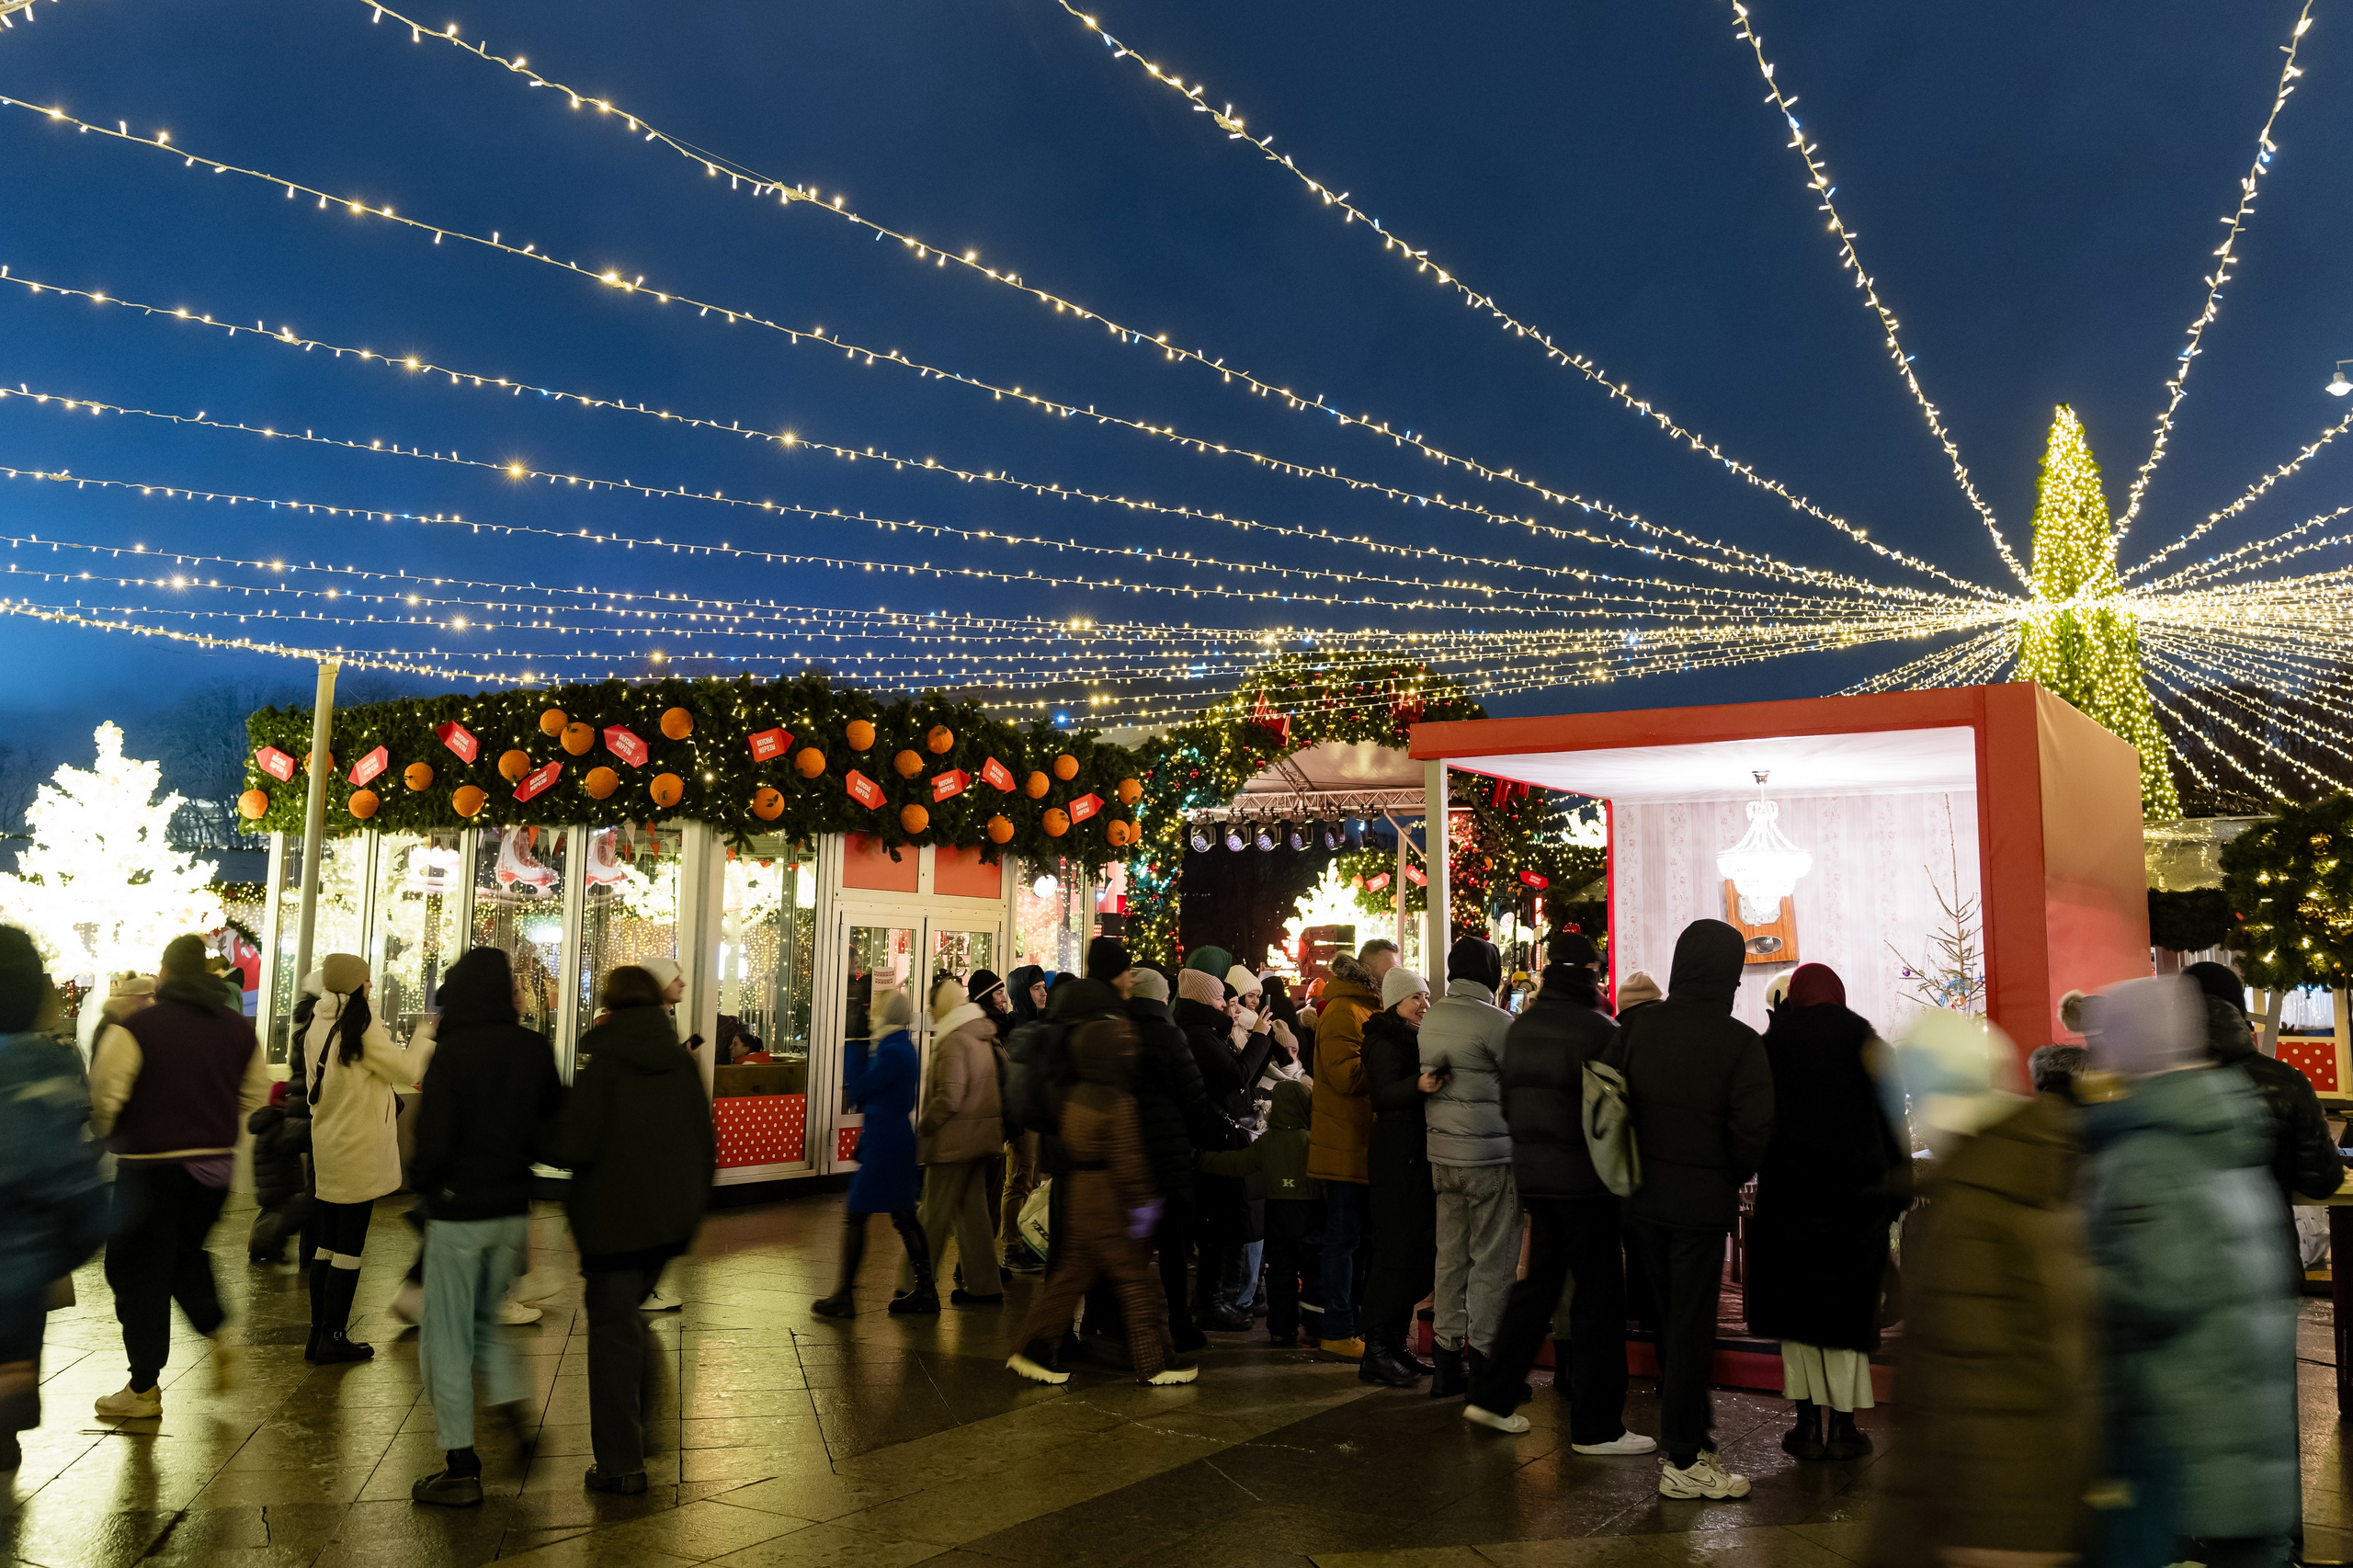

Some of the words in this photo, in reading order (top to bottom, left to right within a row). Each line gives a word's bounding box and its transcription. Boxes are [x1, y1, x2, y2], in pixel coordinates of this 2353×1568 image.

[618, 733, 636, 749] ВКУСНЫЕ
[756, 735, 774, 746] ВКУСНЫЕ
[616, 740, 633, 756] МОРОЗЫ
[758, 743, 776, 754] МОРОЗЫ
